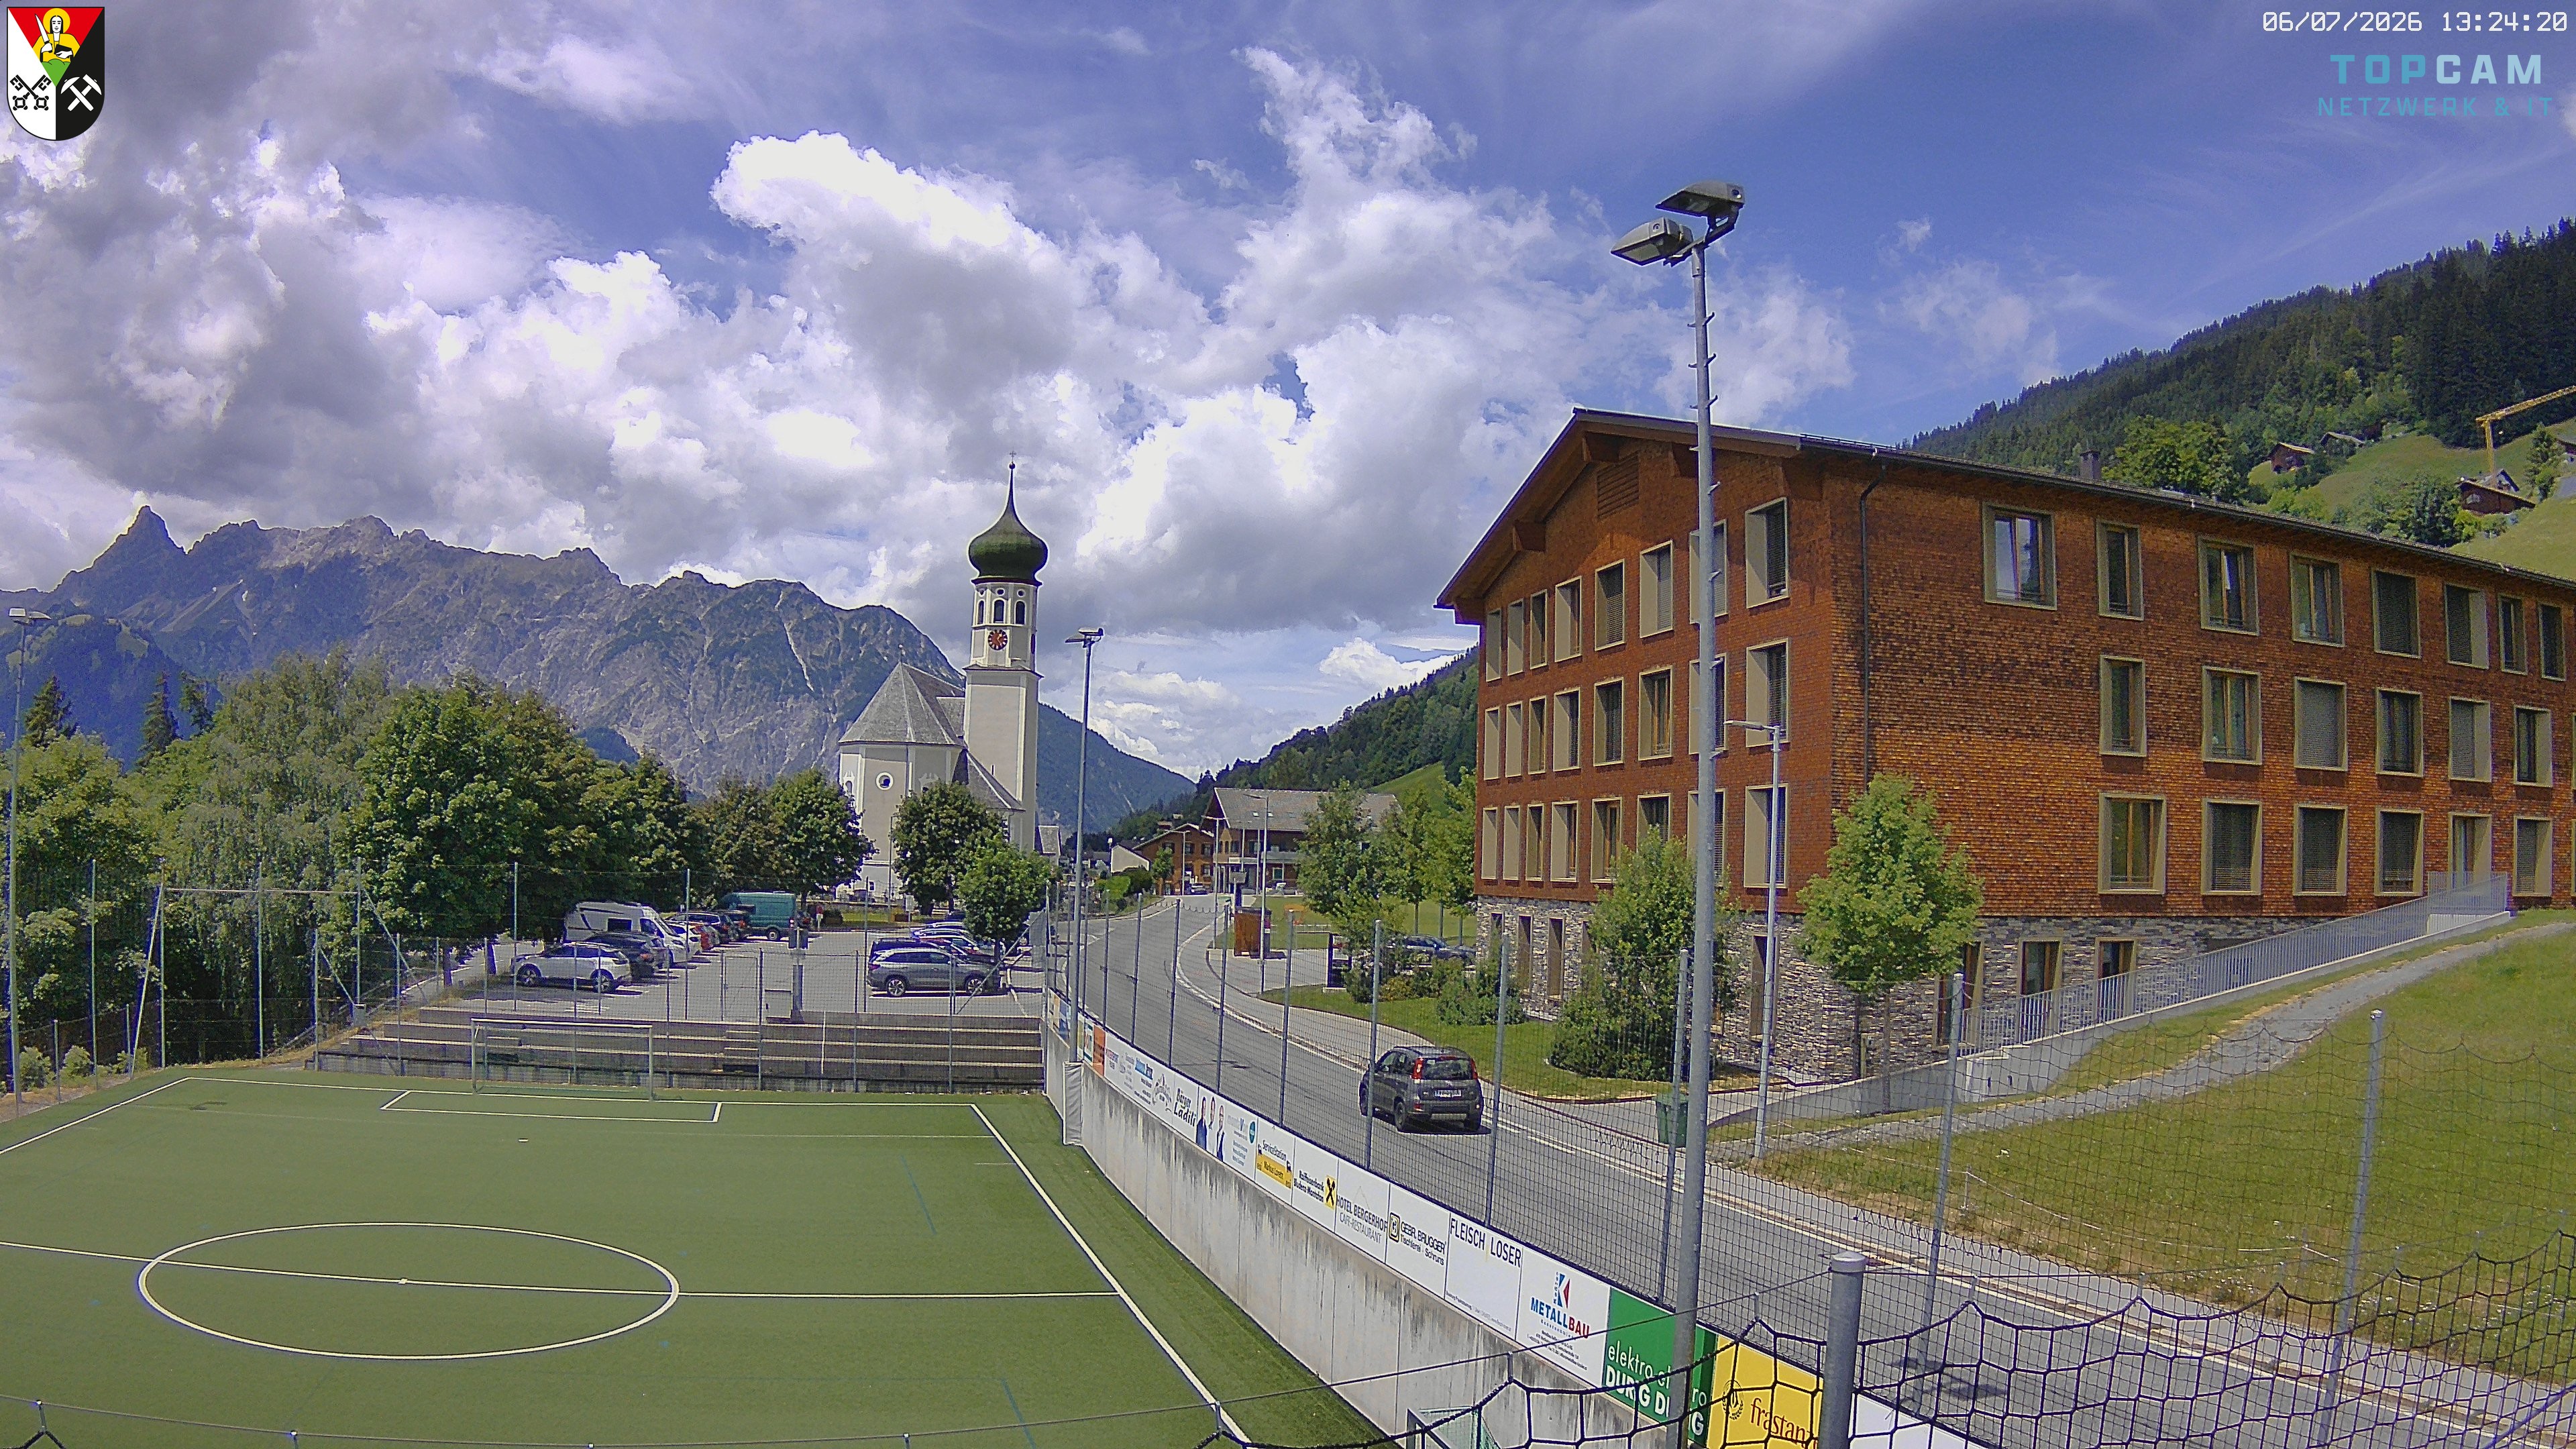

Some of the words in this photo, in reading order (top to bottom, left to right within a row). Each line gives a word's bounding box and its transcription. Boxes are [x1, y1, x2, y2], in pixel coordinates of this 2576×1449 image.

[1336, 1194, 1352, 1214] HOTEL
[1450, 1218, 1486, 1250] FLEISCH
[1490, 1236, 1521, 1268] LOSER
[1530, 1297, 1590, 1339] METALLBAU
[1608, 1340, 1653, 1380] elektro
[1605, 1364, 1651, 1407] DURG
